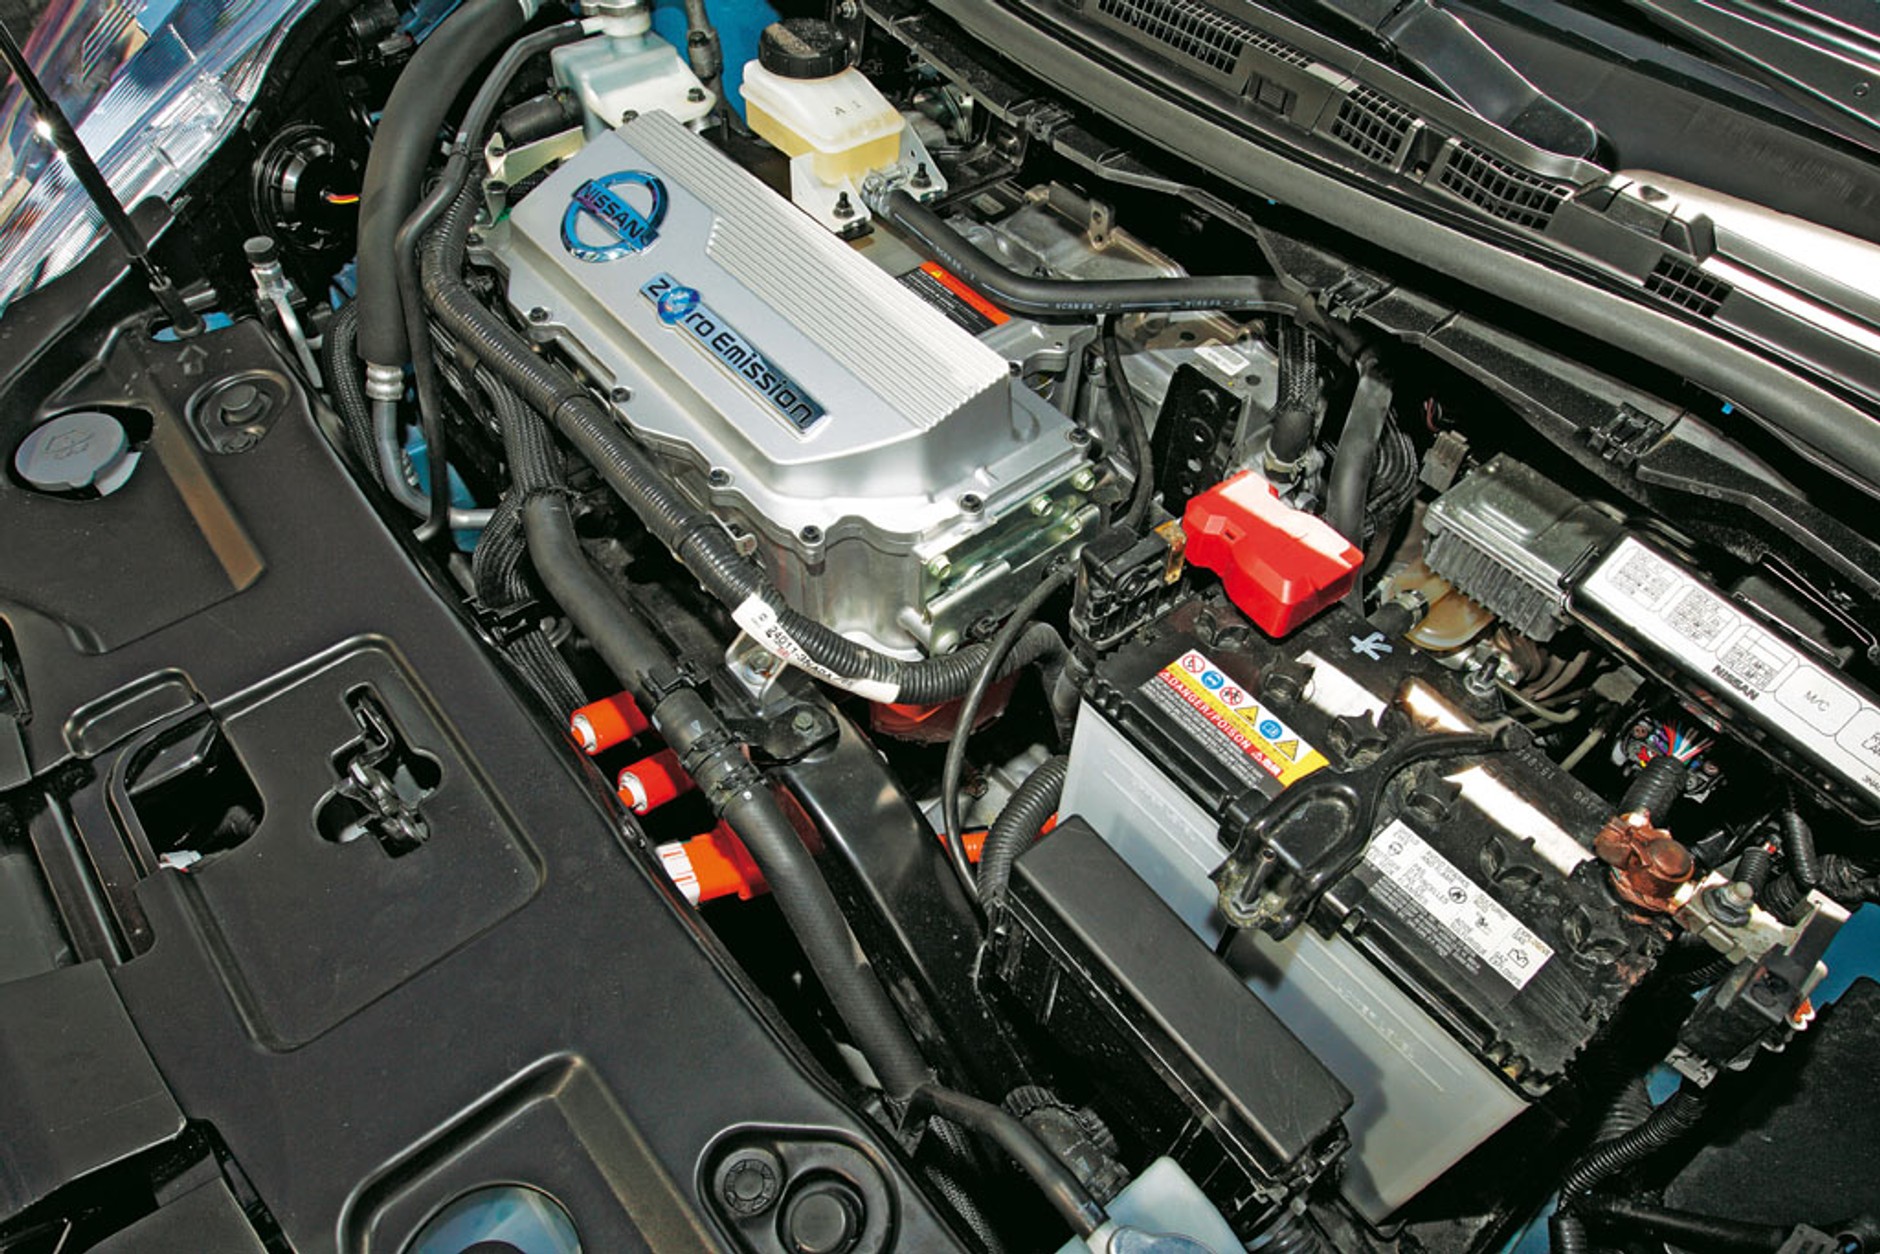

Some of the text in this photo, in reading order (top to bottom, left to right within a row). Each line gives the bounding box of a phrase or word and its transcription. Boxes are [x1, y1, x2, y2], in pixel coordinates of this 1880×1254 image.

[580, 184, 645, 239] NISSAN
[711, 332, 813, 424] Emission
[1711, 665, 1760, 700] NISSAN
[1804, 689, 1831, 713] M/C
[1167, 678, 1252, 750] DANGER/POISON
